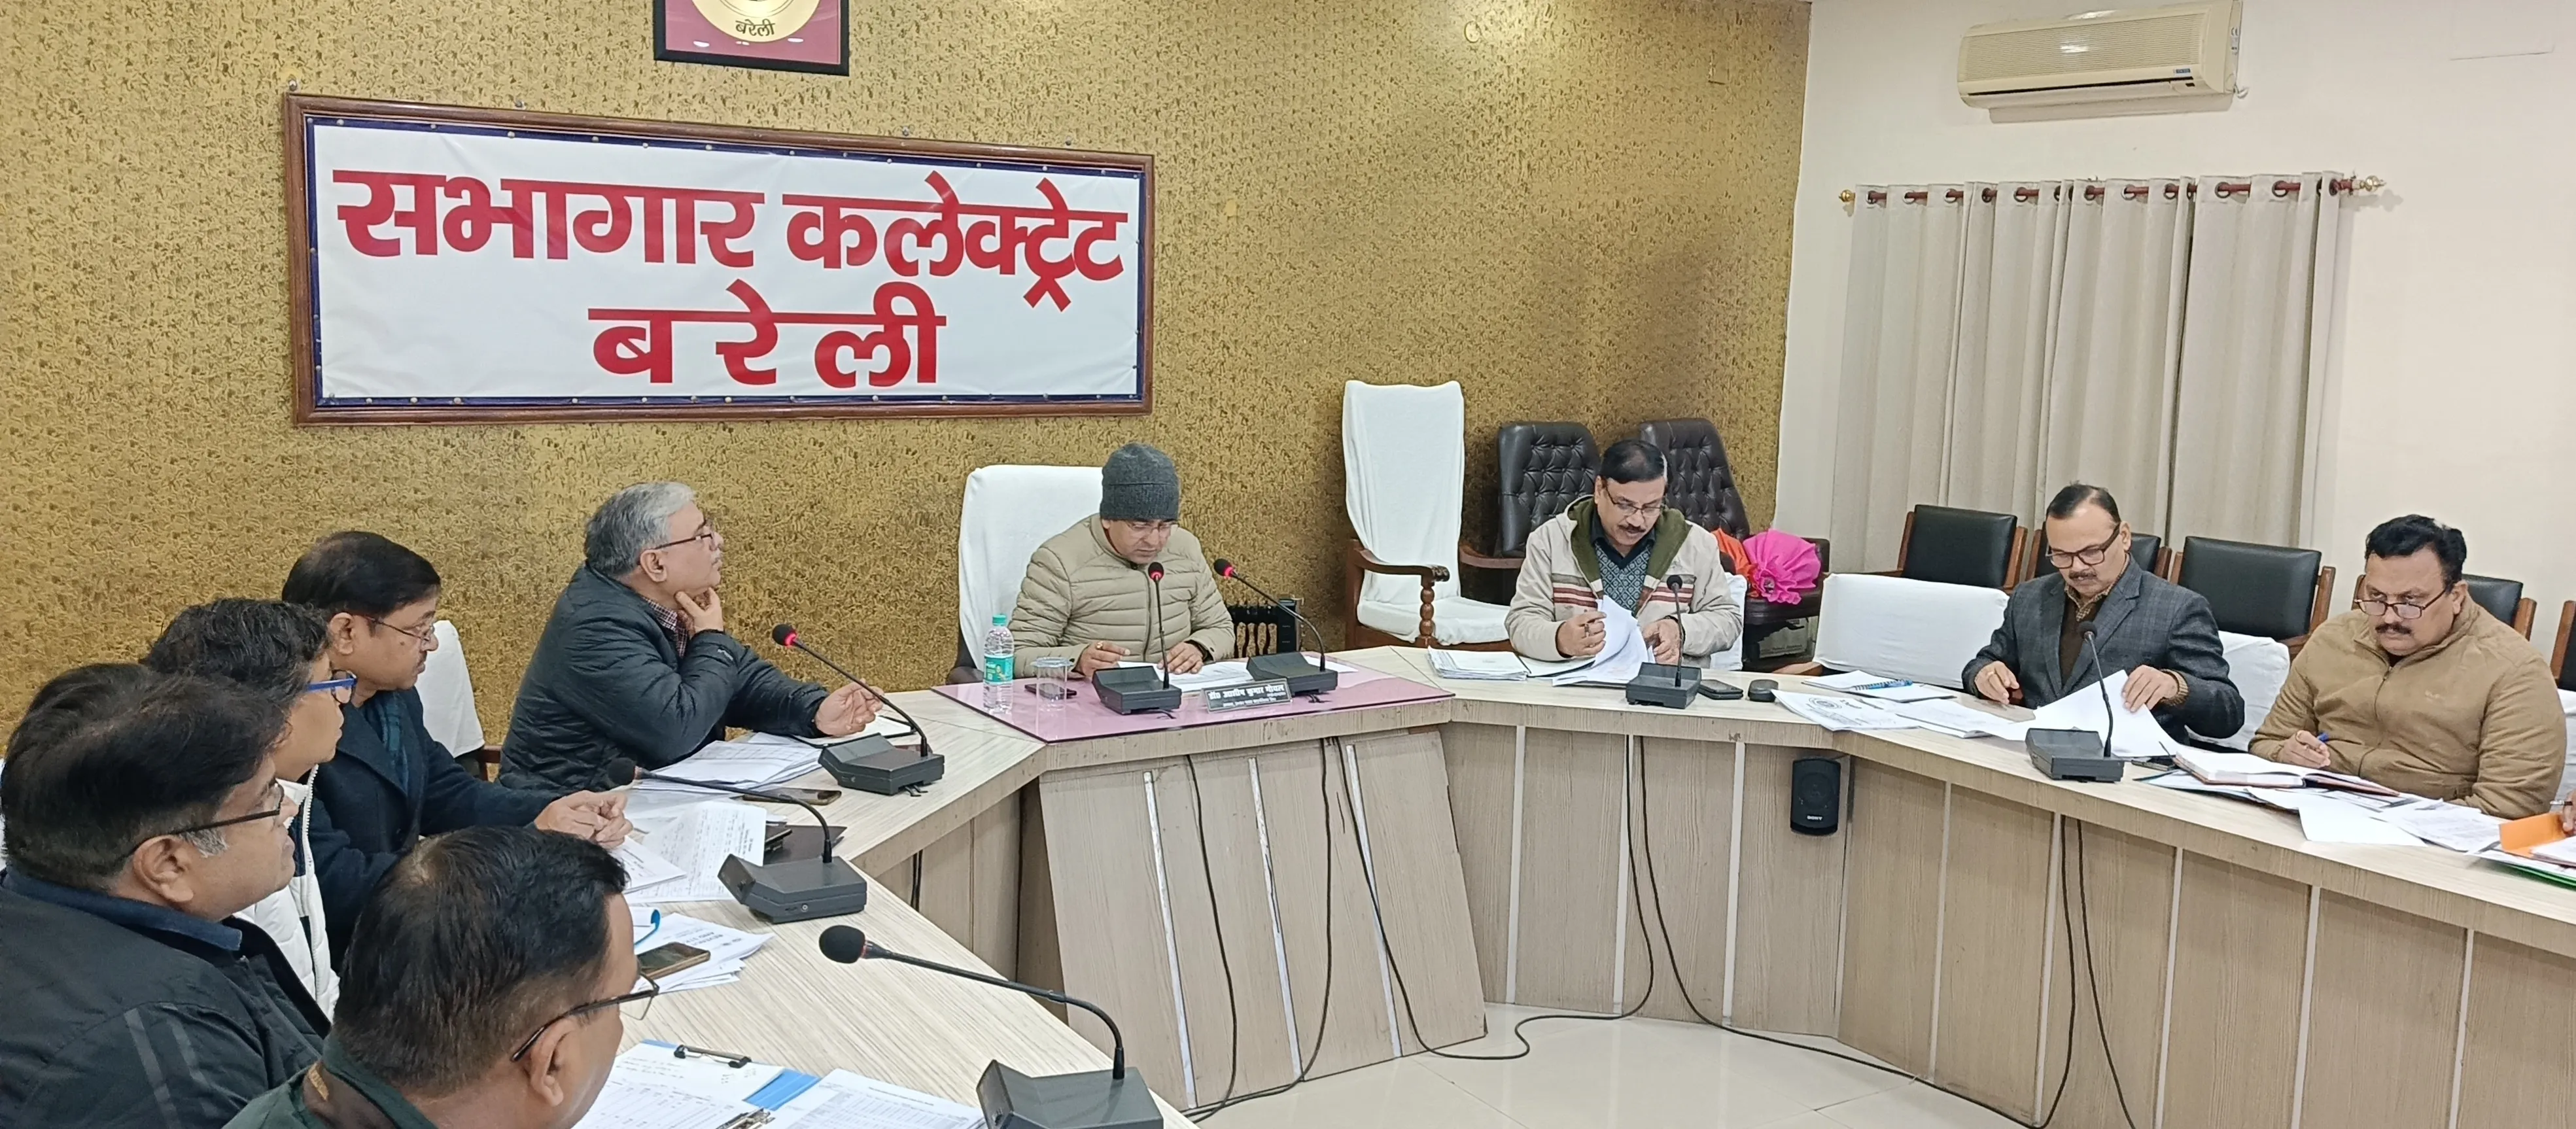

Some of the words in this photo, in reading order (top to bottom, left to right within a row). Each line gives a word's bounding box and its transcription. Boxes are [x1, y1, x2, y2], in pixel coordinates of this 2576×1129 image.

[735, 18, 775, 36] बरेली
[333, 169, 765, 267] सभागार
[782, 170, 1128, 312] कलेक्ट्रेट
[588, 278, 947, 389] बरेली
